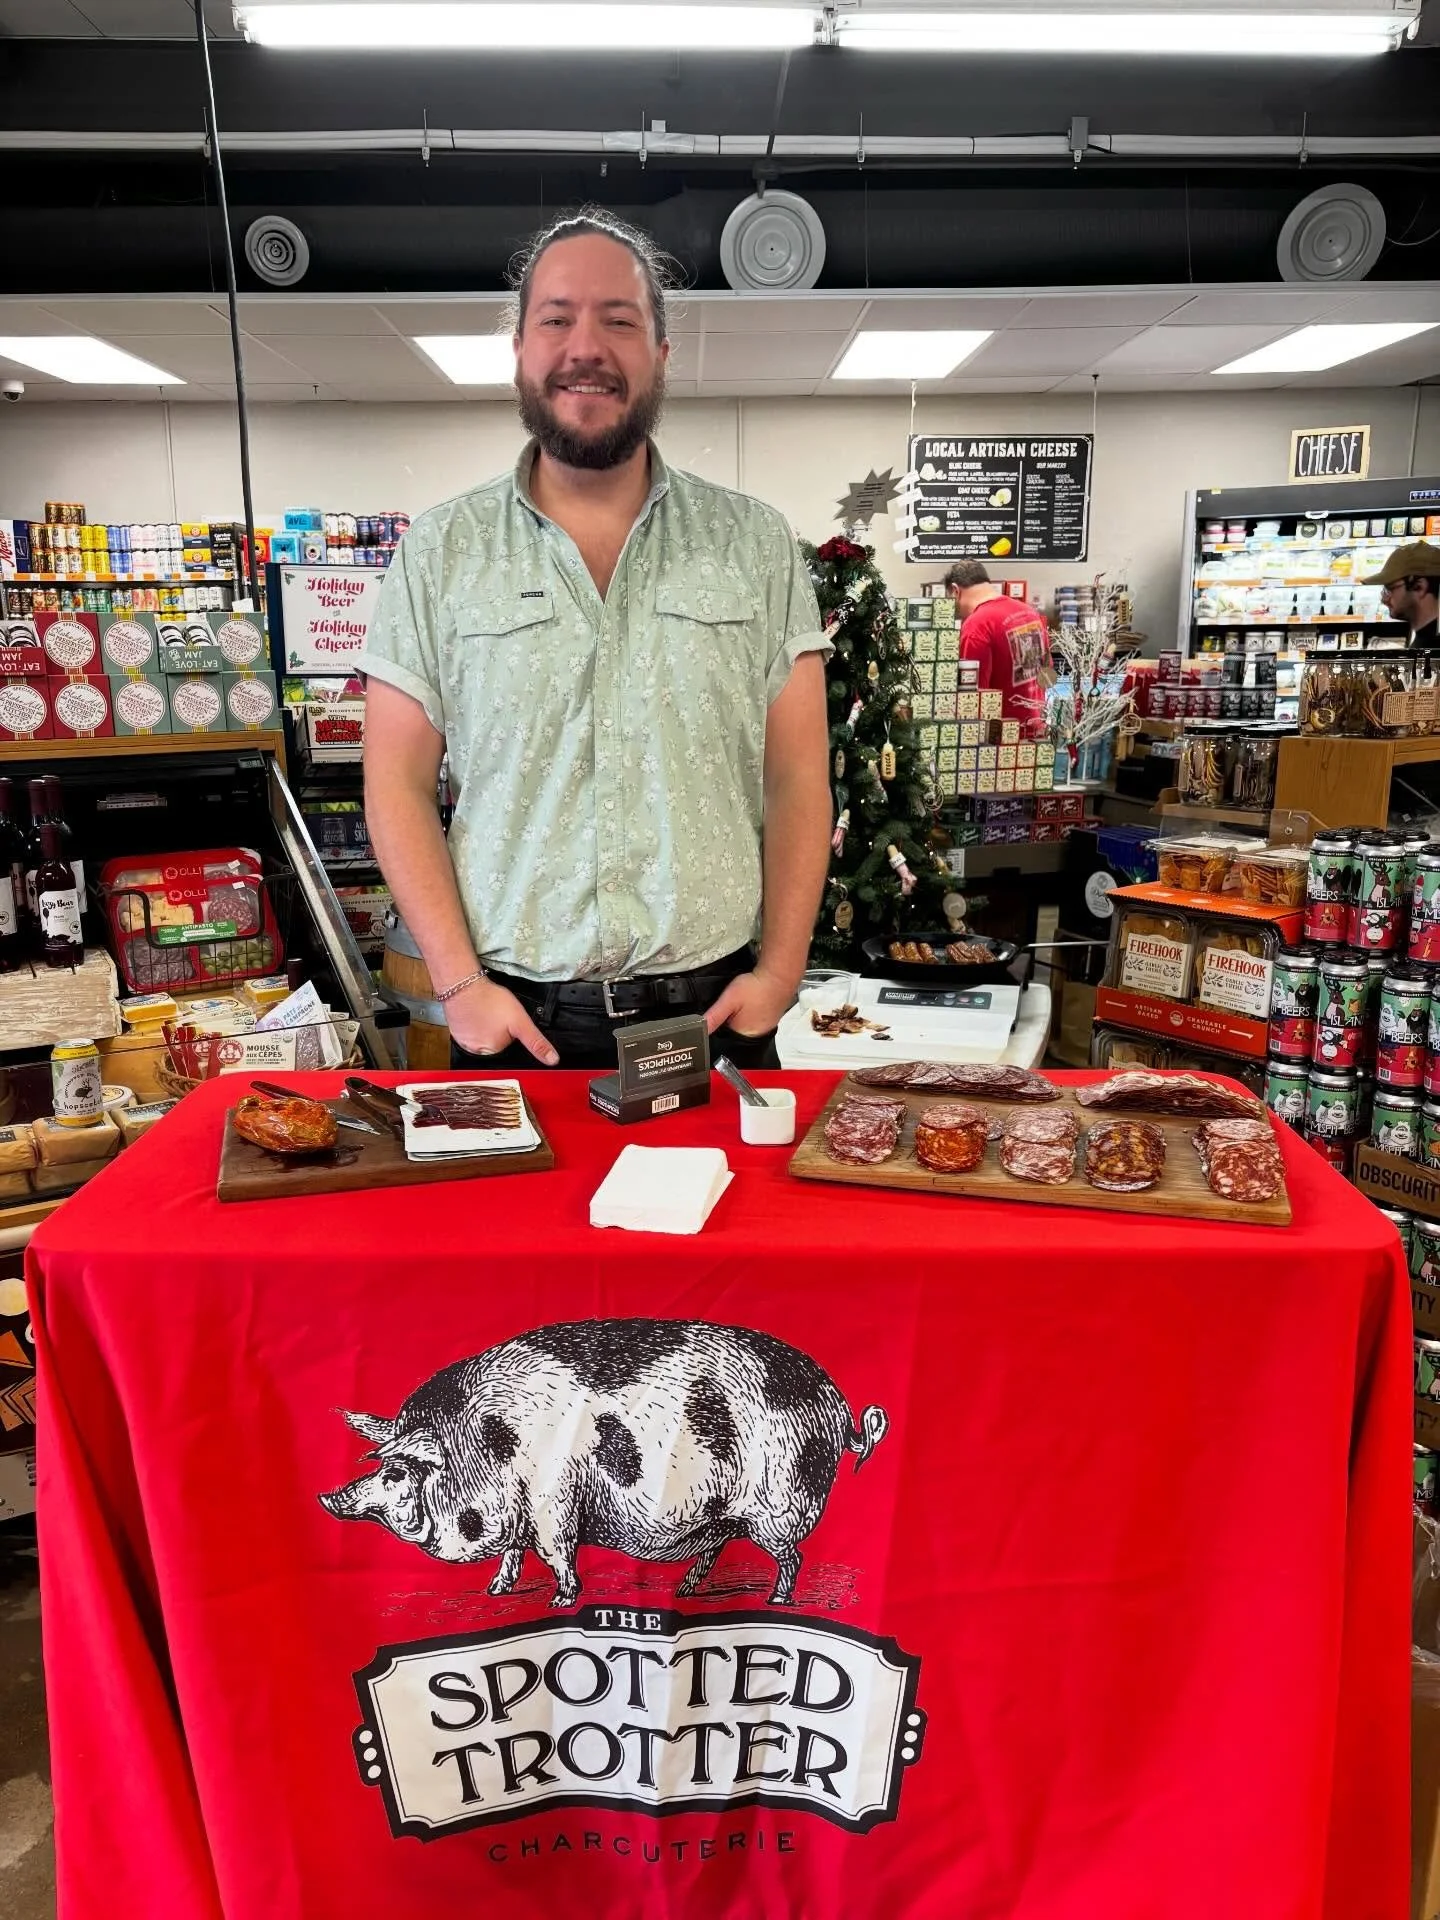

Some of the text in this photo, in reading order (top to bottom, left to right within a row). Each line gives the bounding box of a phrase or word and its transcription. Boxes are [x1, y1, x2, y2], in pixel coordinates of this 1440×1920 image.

[925, 442, 1078, 458] LOCAL ARTISAN CHEESE
[1298, 432, 1360, 476] CHEESE
[304, 577, 365, 596] Holiday
[318, 594, 355, 607] Beer
[306, 620, 366, 638] Holiday
[314, 637, 362, 653] Cheer!
[2, 652, 22, 661] JAM
[184, 651, 204, 659] JAM
[180, 866, 202, 876] OLLI
[184, 888, 206, 898] OLLI
[1311, 888, 1338, 901] BEERS
[56, 899, 74, 908] Bear
[181, 922, 214, 931] ANTIPASTO
[1130, 939, 1183, 961] FIREHOOK
[1208, 954, 1266, 978] FIREHOOK
[284, 1000, 316, 1026] CAMPAGNE
[1134, 1004, 1162, 1014] ARTISAN
[1136, 1011, 1158, 1020] BAKED
[1281, 1006, 1310, 1017] BEERS
[1186, 1016, 1227, 1030] CRAVEABLE
[1192, 1023, 1221, 1034] CRUNCH
[1391, 1032, 1424, 1044] BEERS
[246, 1044, 280, 1052] MOUSSE
[638, 1052, 692, 1071] TOOTHPICKS
[595, 1609, 662, 1631] THE
[428, 1644, 854, 1731] SPOTTED
[432, 1722, 848, 1805] TROTTER
[488, 1831, 796, 1863] CHARCUTERIE
